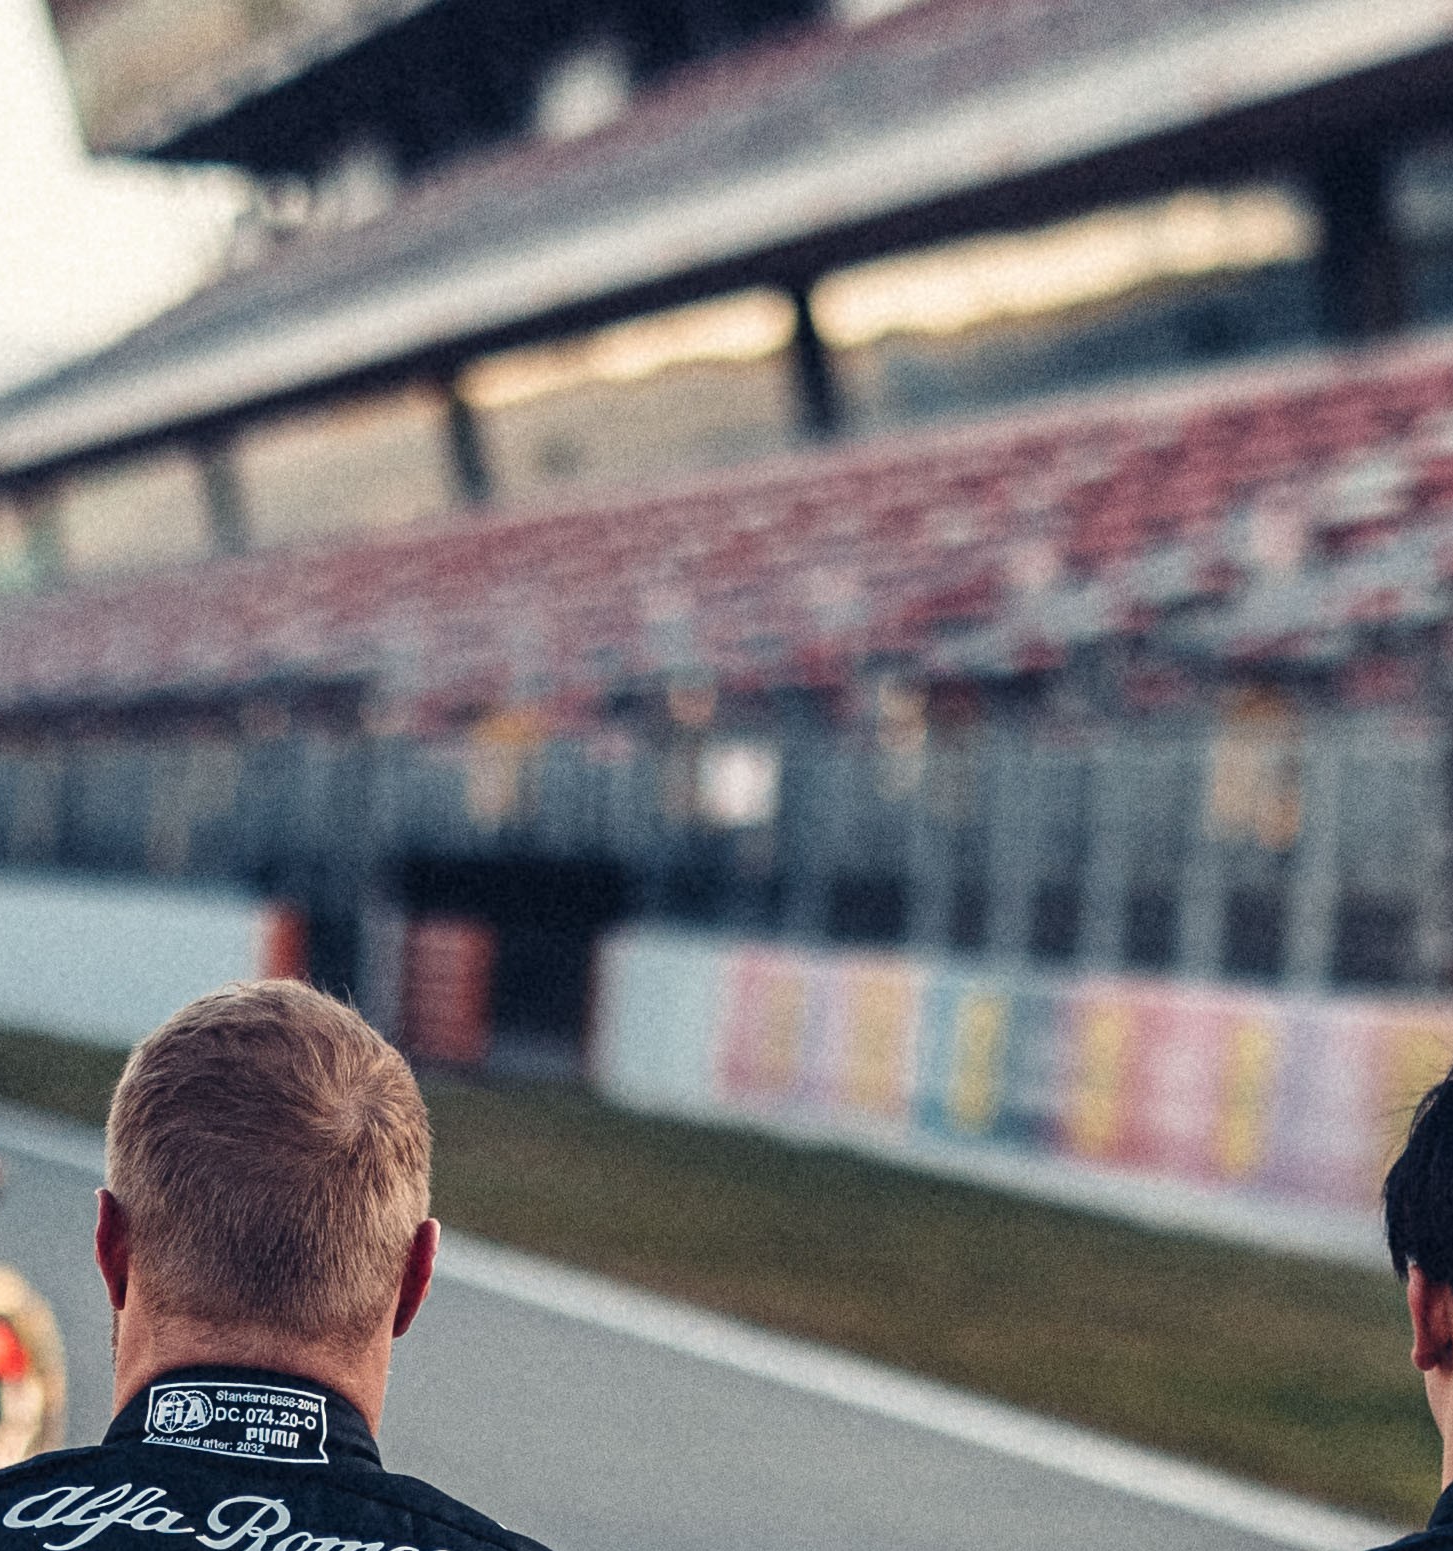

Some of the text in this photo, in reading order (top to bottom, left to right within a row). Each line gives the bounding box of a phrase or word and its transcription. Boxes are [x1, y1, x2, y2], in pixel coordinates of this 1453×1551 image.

[215, 1390, 268, 1404] Standard
[175, 1435, 200, 1446] valid
[202, 1438, 233, 1451] after:
[236, 1442, 265, 1454] 2032
[245, 1427, 300, 1448] PUMA
[3, 1483, 195, 1551] Alfa
